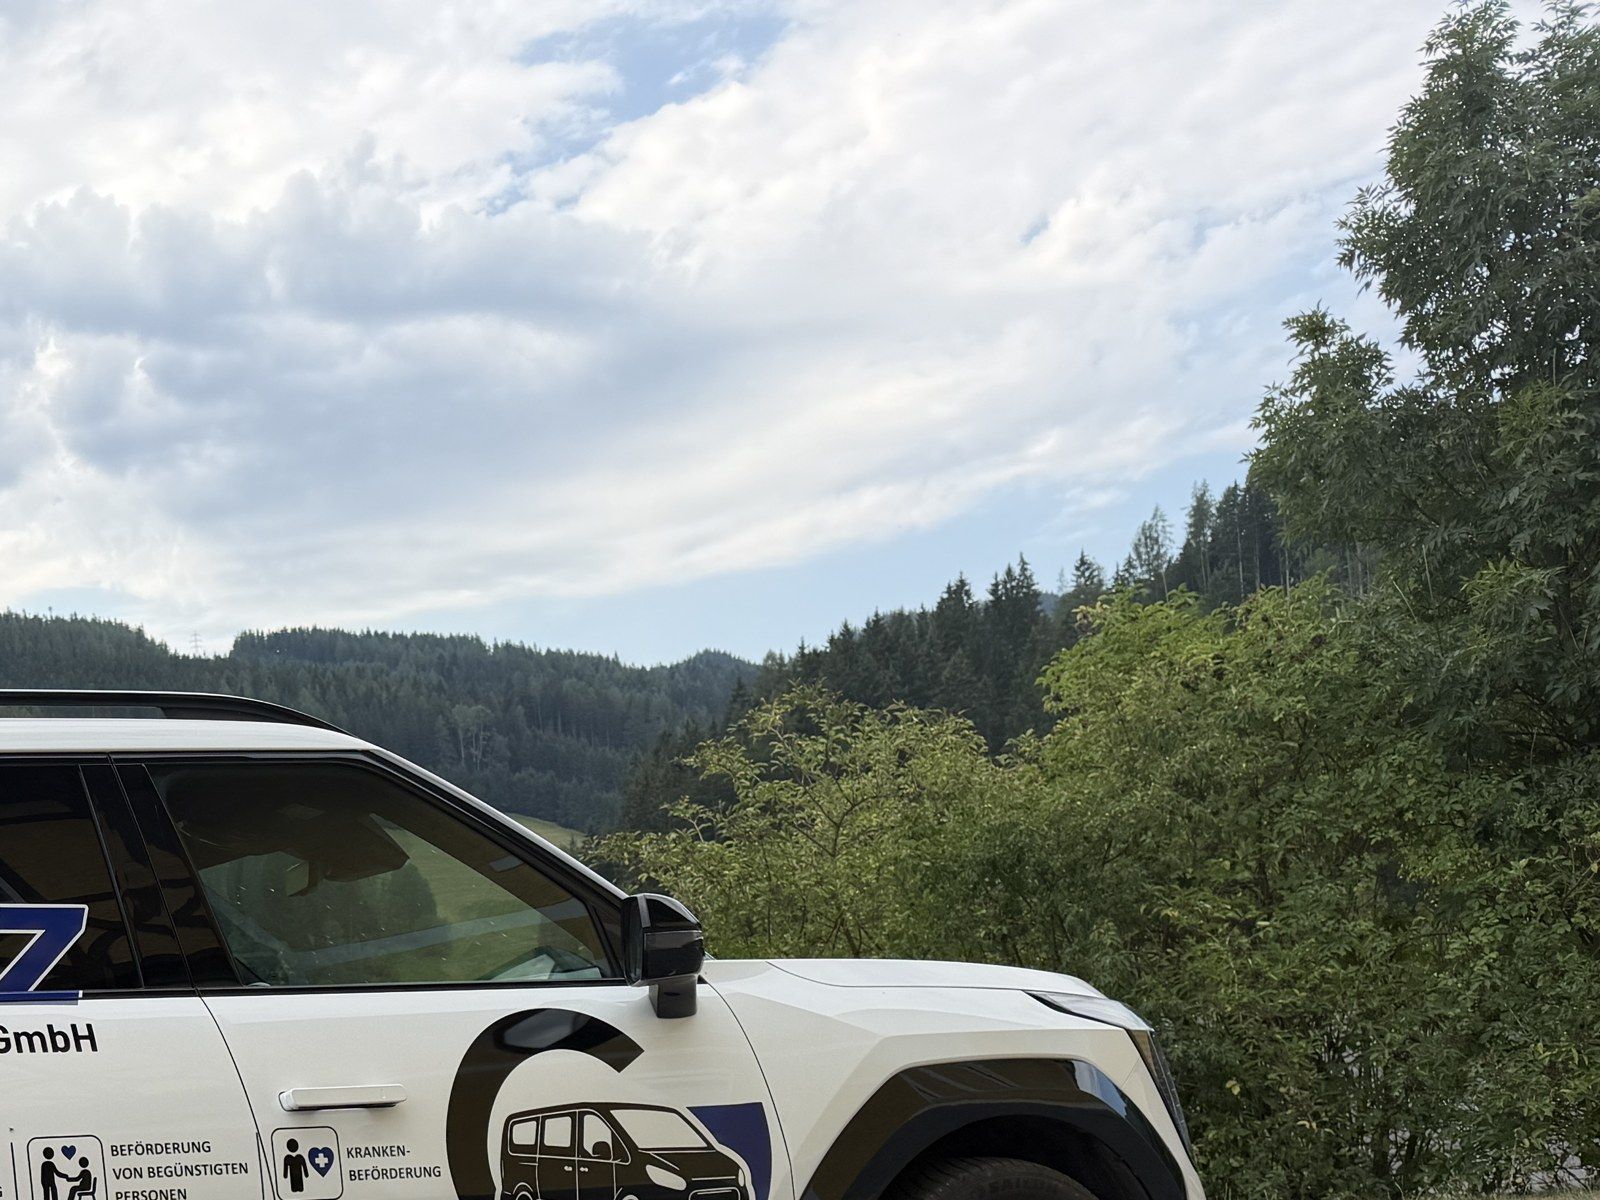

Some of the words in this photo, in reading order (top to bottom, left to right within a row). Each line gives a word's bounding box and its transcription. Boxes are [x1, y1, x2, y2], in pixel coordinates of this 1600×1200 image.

[110, 1140, 212, 1157] BEFÖRDERUNG
[346, 1144, 411, 1160] KRANKEN-
[112, 1166, 144, 1180] VON
[147, 1161, 249, 1179] BEGÜNSTIGTEN
[348, 1165, 442, 1182] BEFÖRDERUNG
